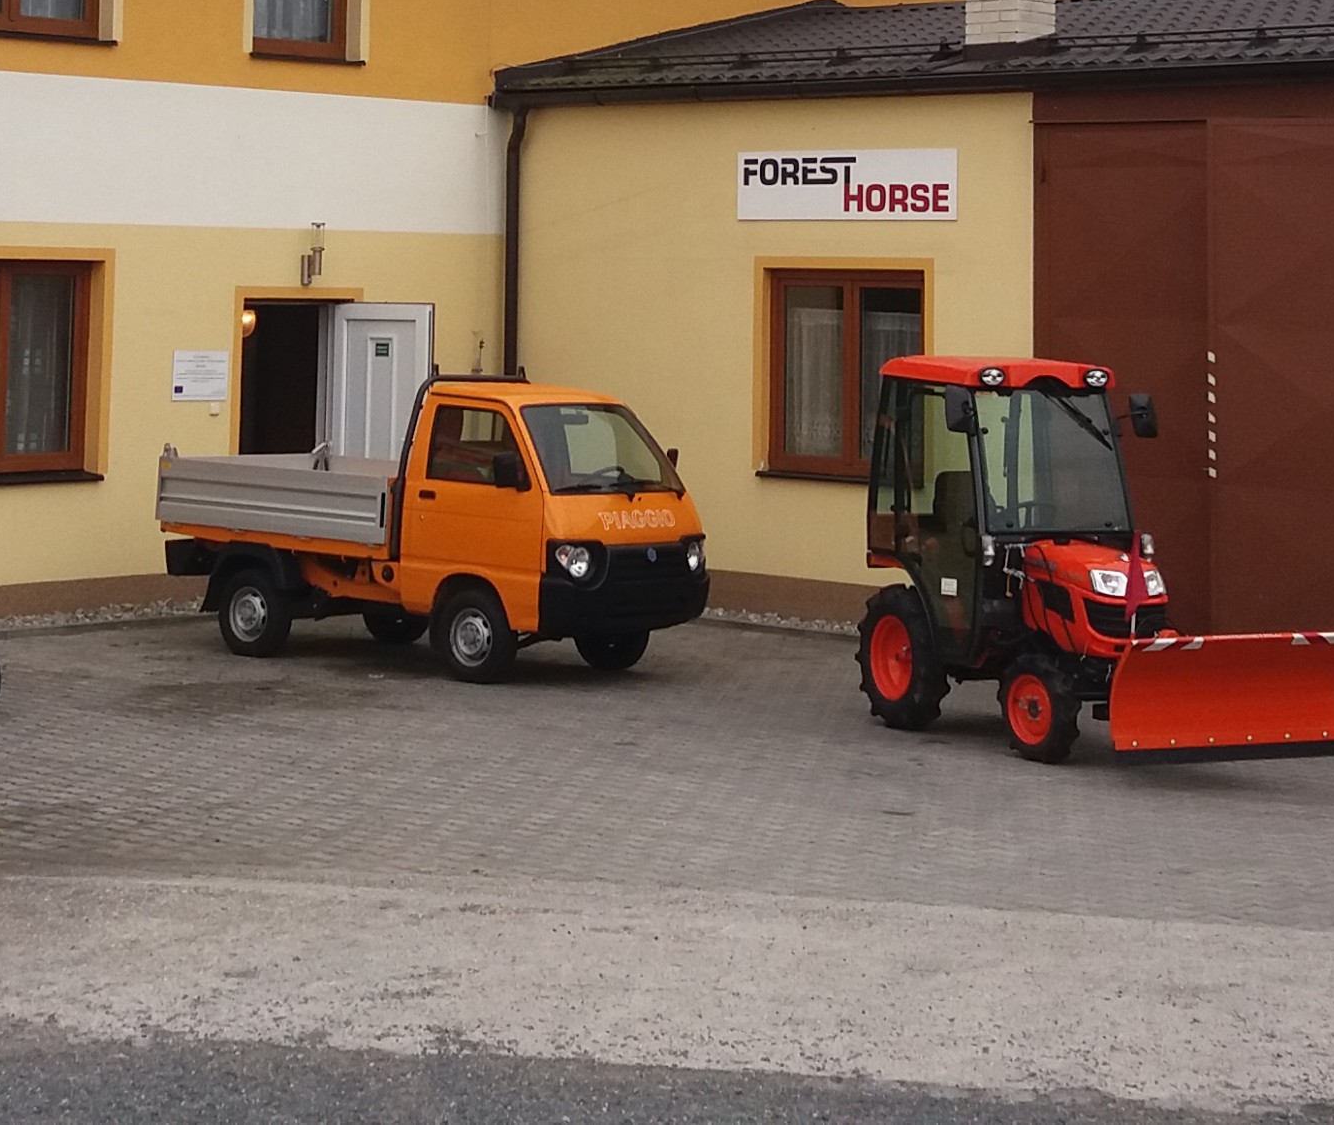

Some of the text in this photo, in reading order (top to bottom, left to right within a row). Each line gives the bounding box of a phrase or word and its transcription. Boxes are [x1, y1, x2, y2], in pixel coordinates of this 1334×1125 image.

[743, 156, 857, 186] FOREST
[843, 183, 950, 213] HORSE
[598, 508, 676, 531] PIAGGIO
